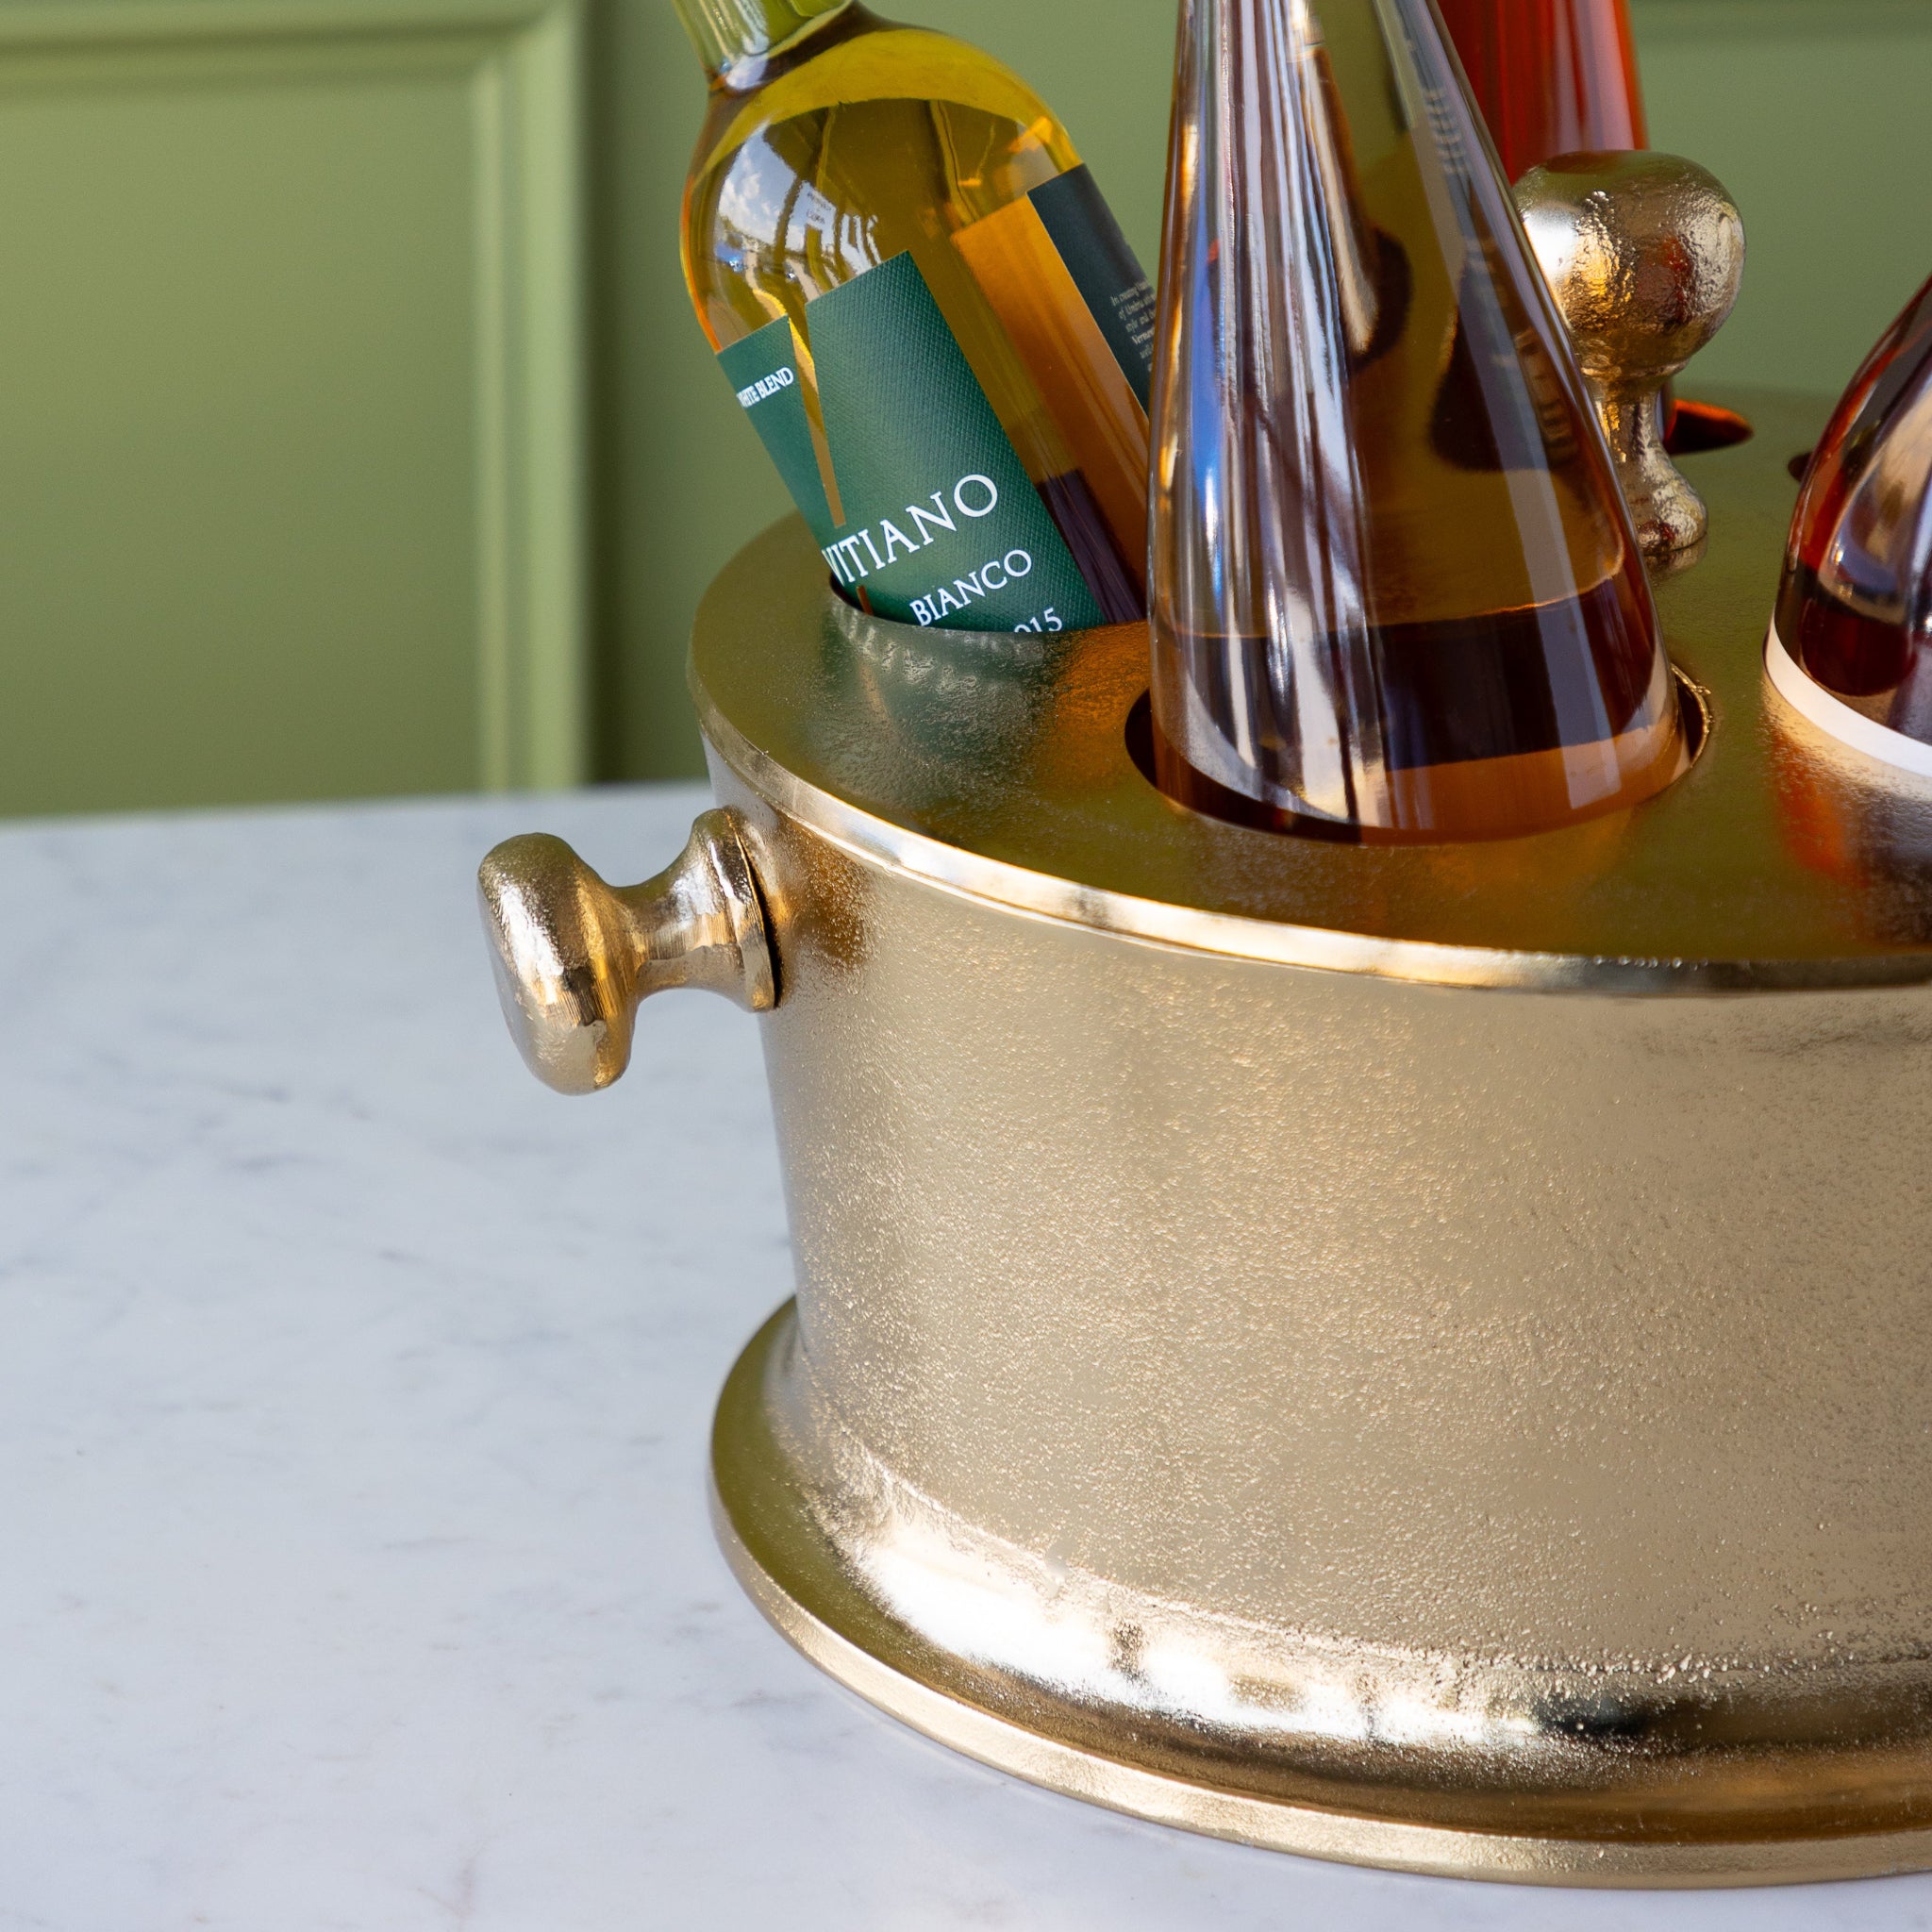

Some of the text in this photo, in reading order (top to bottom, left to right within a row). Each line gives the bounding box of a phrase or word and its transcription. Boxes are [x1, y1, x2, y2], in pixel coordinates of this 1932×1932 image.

[754, 367, 794, 399] BLEND
[822, 474, 998, 587] VITIANO
[909, 549, 1032, 626] BIANCO
